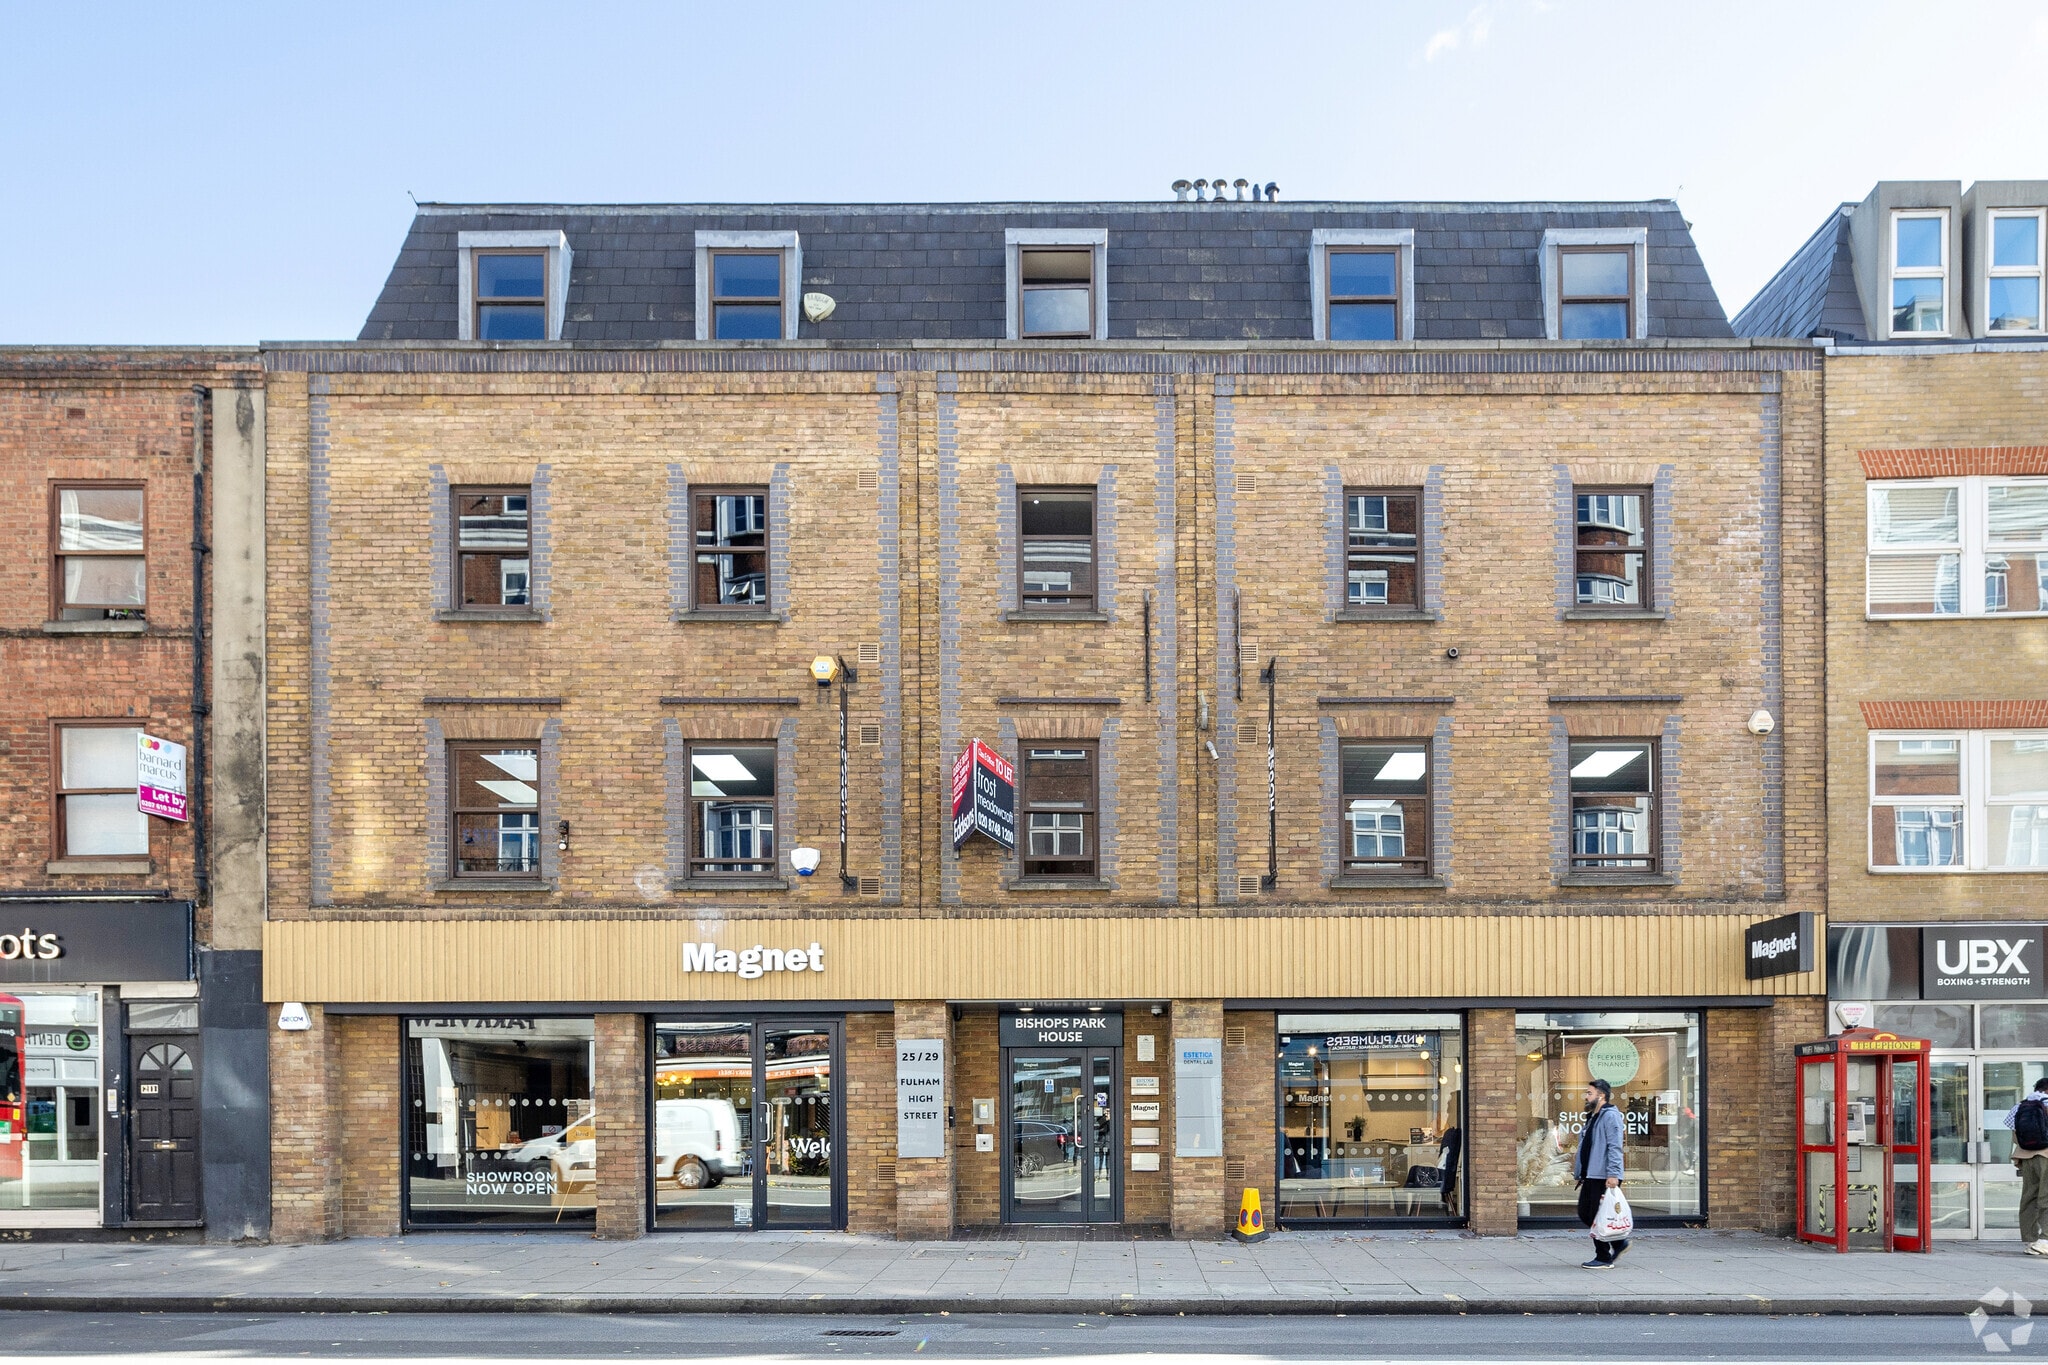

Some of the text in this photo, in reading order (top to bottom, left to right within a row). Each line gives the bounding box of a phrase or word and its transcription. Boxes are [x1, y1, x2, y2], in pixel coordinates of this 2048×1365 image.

[139, 748, 182, 771] barnard
[139, 762, 178, 780] marcus
[995, 757, 1004, 775] TO
[1004, 765, 1013, 782] LET
[977, 767, 997, 799] frost
[152, 789, 186, 809] Let by
[978, 811, 988, 829] 020
[1751, 932, 1797, 959] Magnet
[682, 942, 825, 979] Magnet
[1937, 939, 2030, 975] UBX
[1937, 978, 1974, 986] BOXING
[1980, 978, 2030, 986] STRENGTH
[1015, 1018, 1106, 1029] BISHOPS PARK
[1038, 1031, 1083, 1042] HOUSE
[900, 1078, 940, 1086] FULHAM
[1299, 1094, 1333, 1104] Magnet
[466, 1171, 558, 1183] SHOWROOM
[466, 1184, 558, 1195] NOW OPEN
